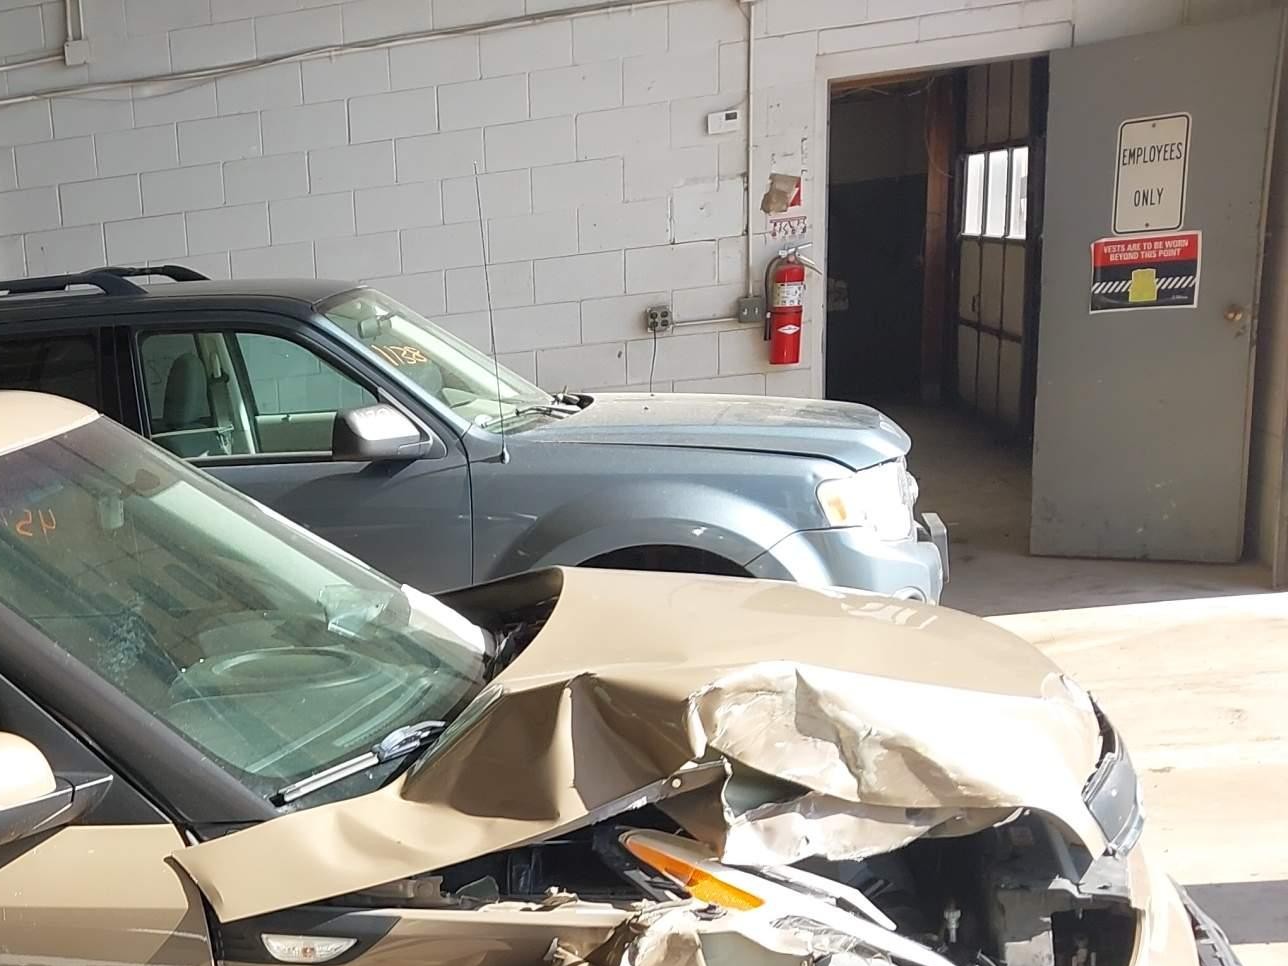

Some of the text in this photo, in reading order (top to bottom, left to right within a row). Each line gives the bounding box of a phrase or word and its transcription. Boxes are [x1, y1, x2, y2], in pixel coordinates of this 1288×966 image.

[1122, 142, 1183, 166] EMPLOYEES
[1134, 187, 1164, 207] ONLY
[1103, 239, 1189, 254] VESTS ARE TO BE WORN
[1109, 248, 1182, 261] BEYOND THIS POINT
